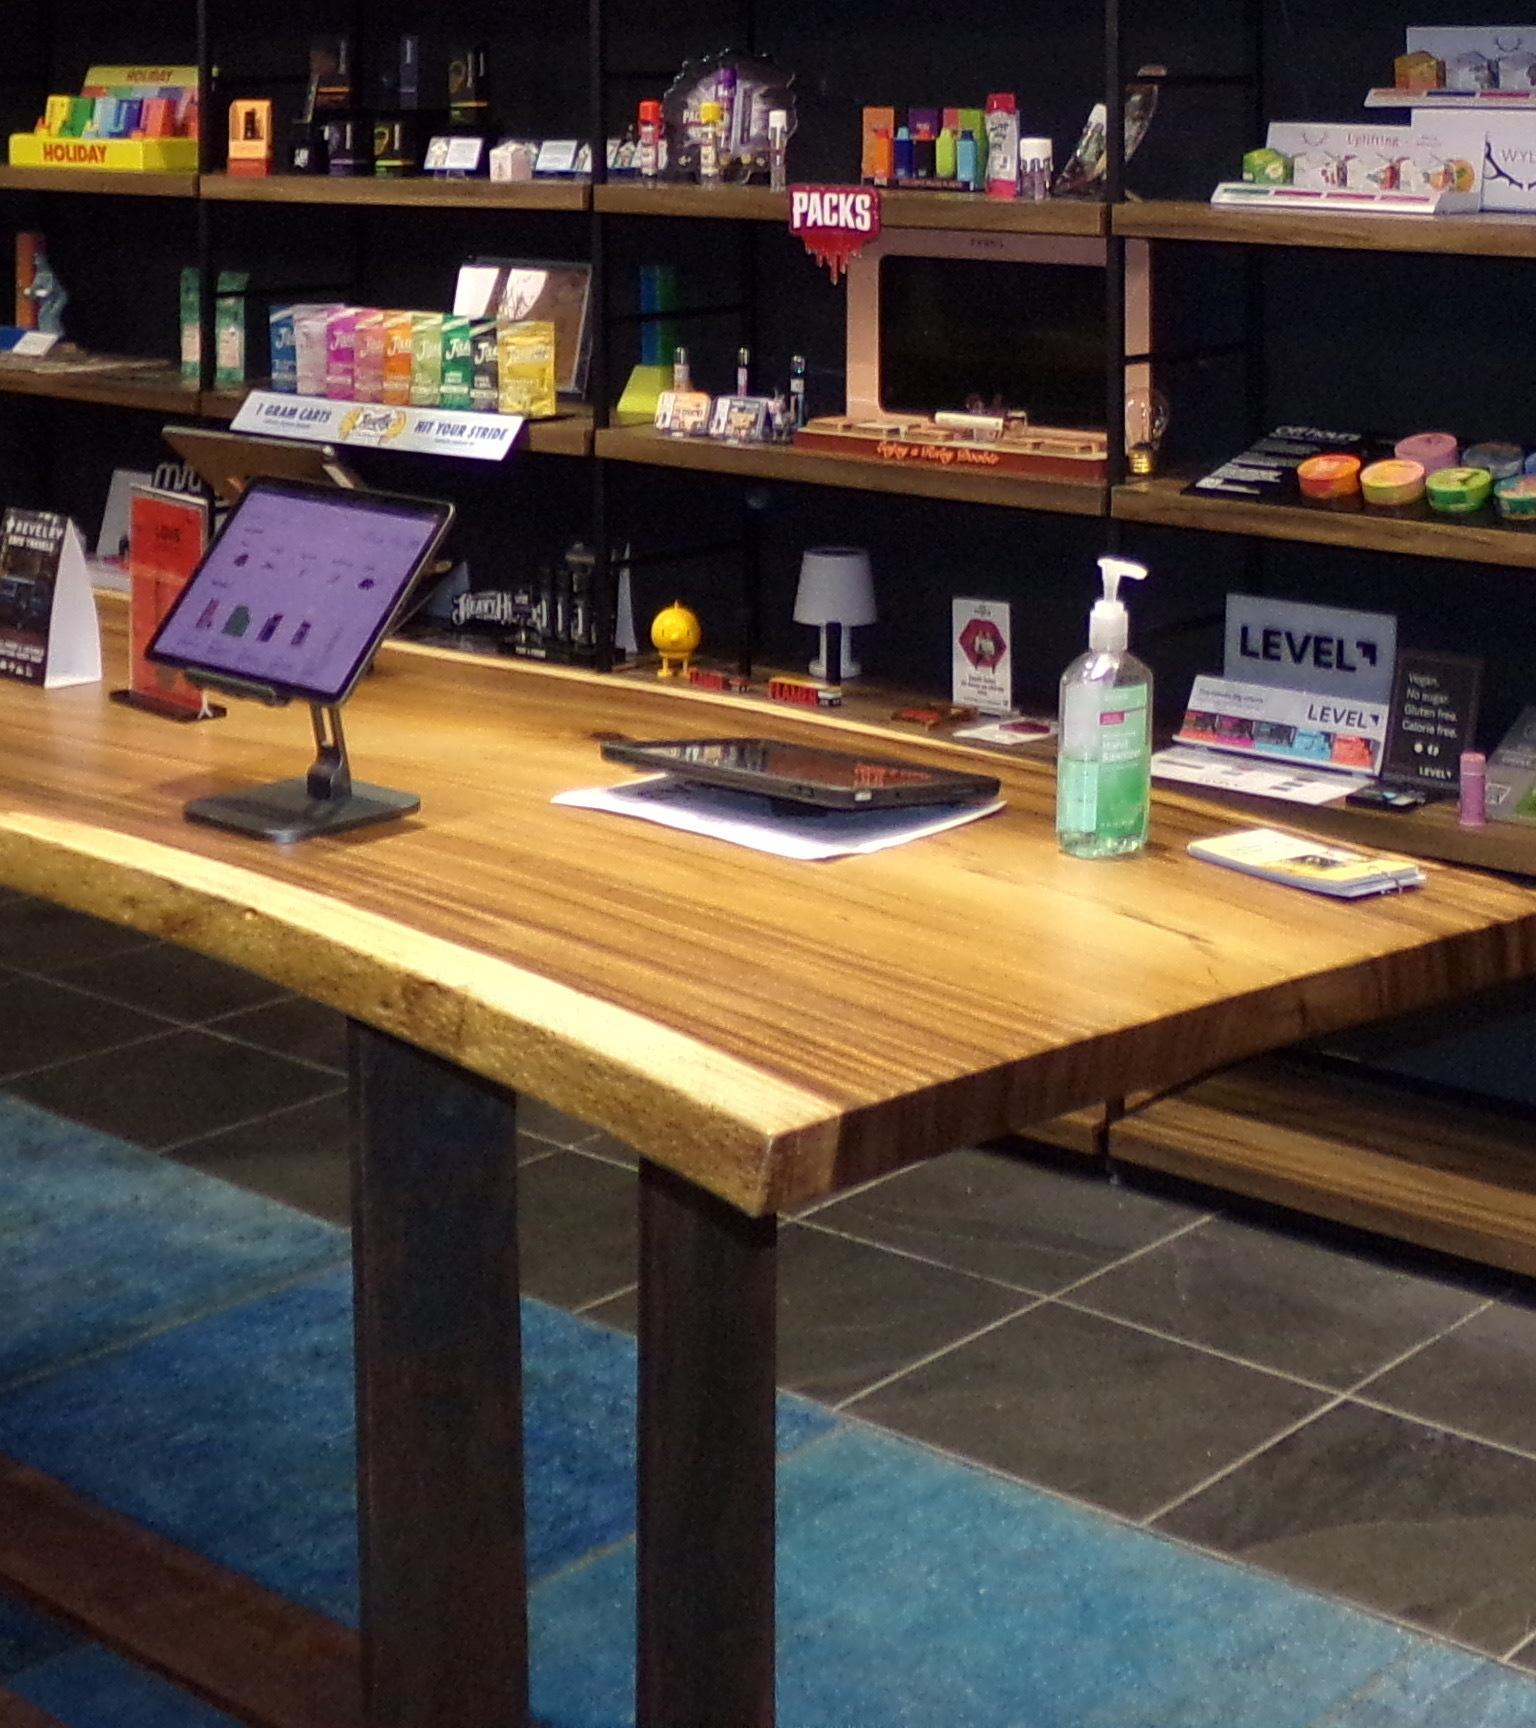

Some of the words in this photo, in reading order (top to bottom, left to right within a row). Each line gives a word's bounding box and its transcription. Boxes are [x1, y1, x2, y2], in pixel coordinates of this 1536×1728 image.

[43, 144, 108, 163] HOLIDAY
[792, 190, 872, 232] PACKS
[298, 406, 333, 424] CARTS
[414, 420, 435, 435] HIT
[435, 422, 467, 438] YOUR
[467, 425, 509, 441] STRIDE
[1240, 625, 1357, 672] LEVEL
[1406, 687, 1421, 702] No
[1307, 703, 1368, 730] LEVEL
[1404, 703, 1435, 720] Gluten
